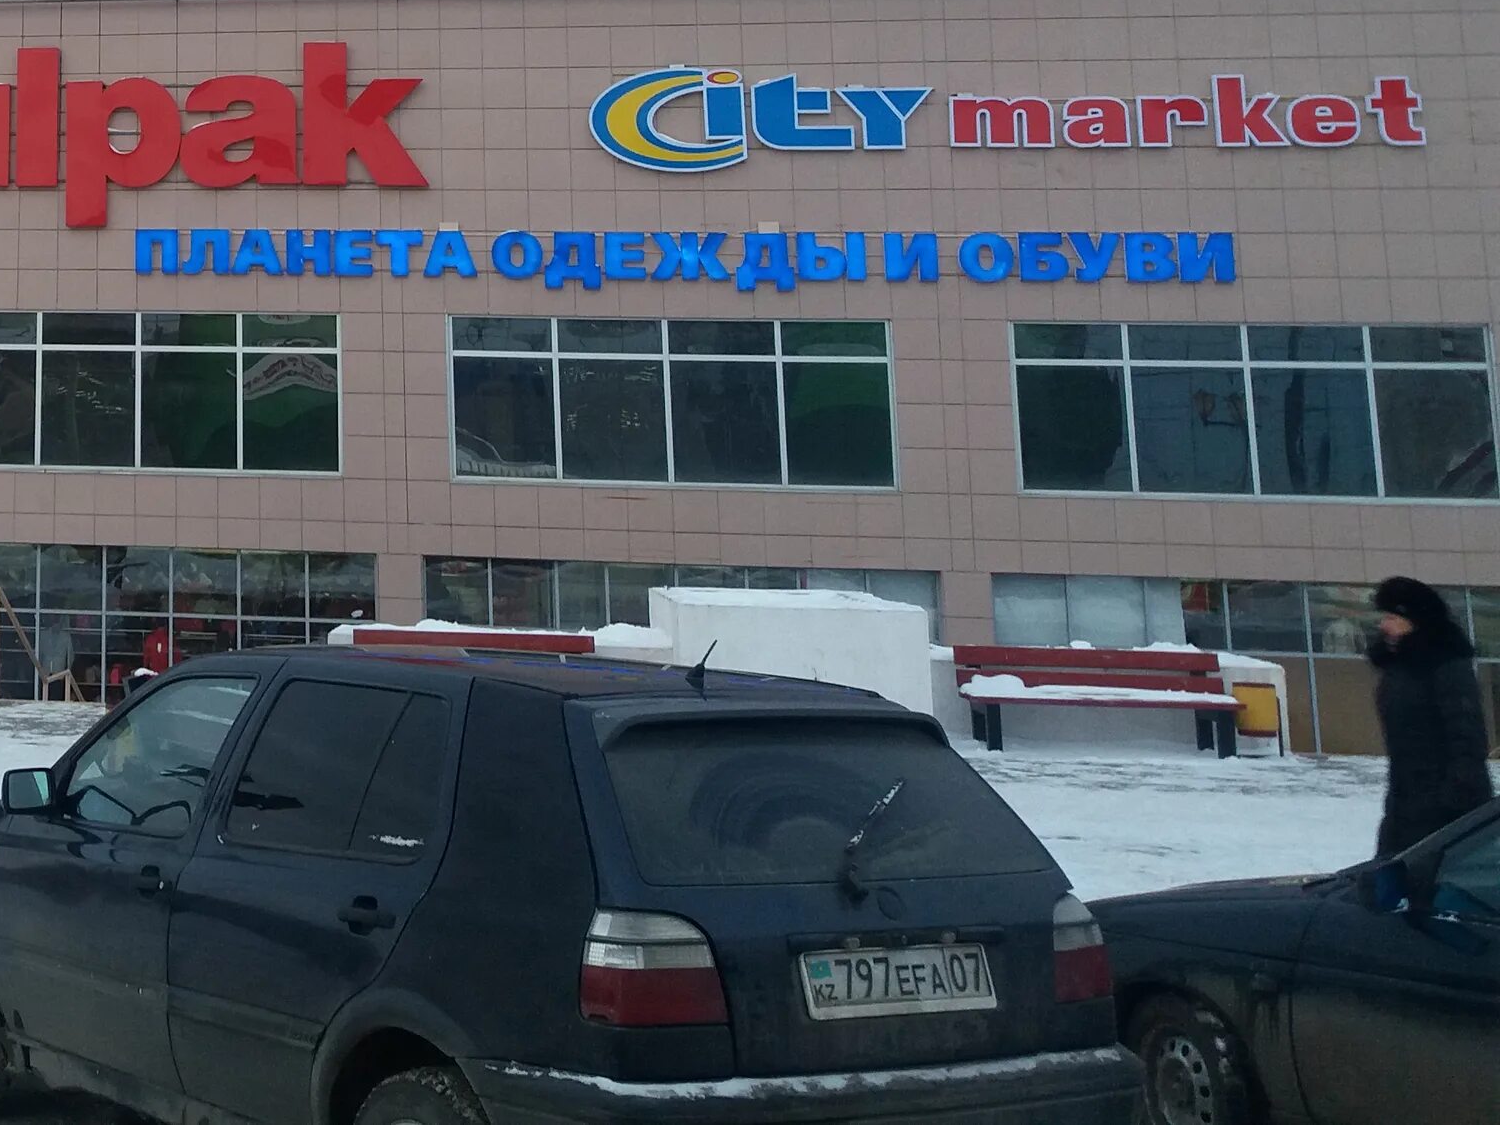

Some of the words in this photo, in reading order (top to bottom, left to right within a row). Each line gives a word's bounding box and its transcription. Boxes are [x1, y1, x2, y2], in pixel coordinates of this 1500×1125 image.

[949, 74, 1428, 149] market
[135, 229, 478, 277] ПЛАНЕТА
[491, 230, 865, 292] ОДЕЖДЫ
[882, 231, 940, 283] И
[958, 232, 1237, 285] ОБУВИ
[813, 984, 838, 1001] KZ
